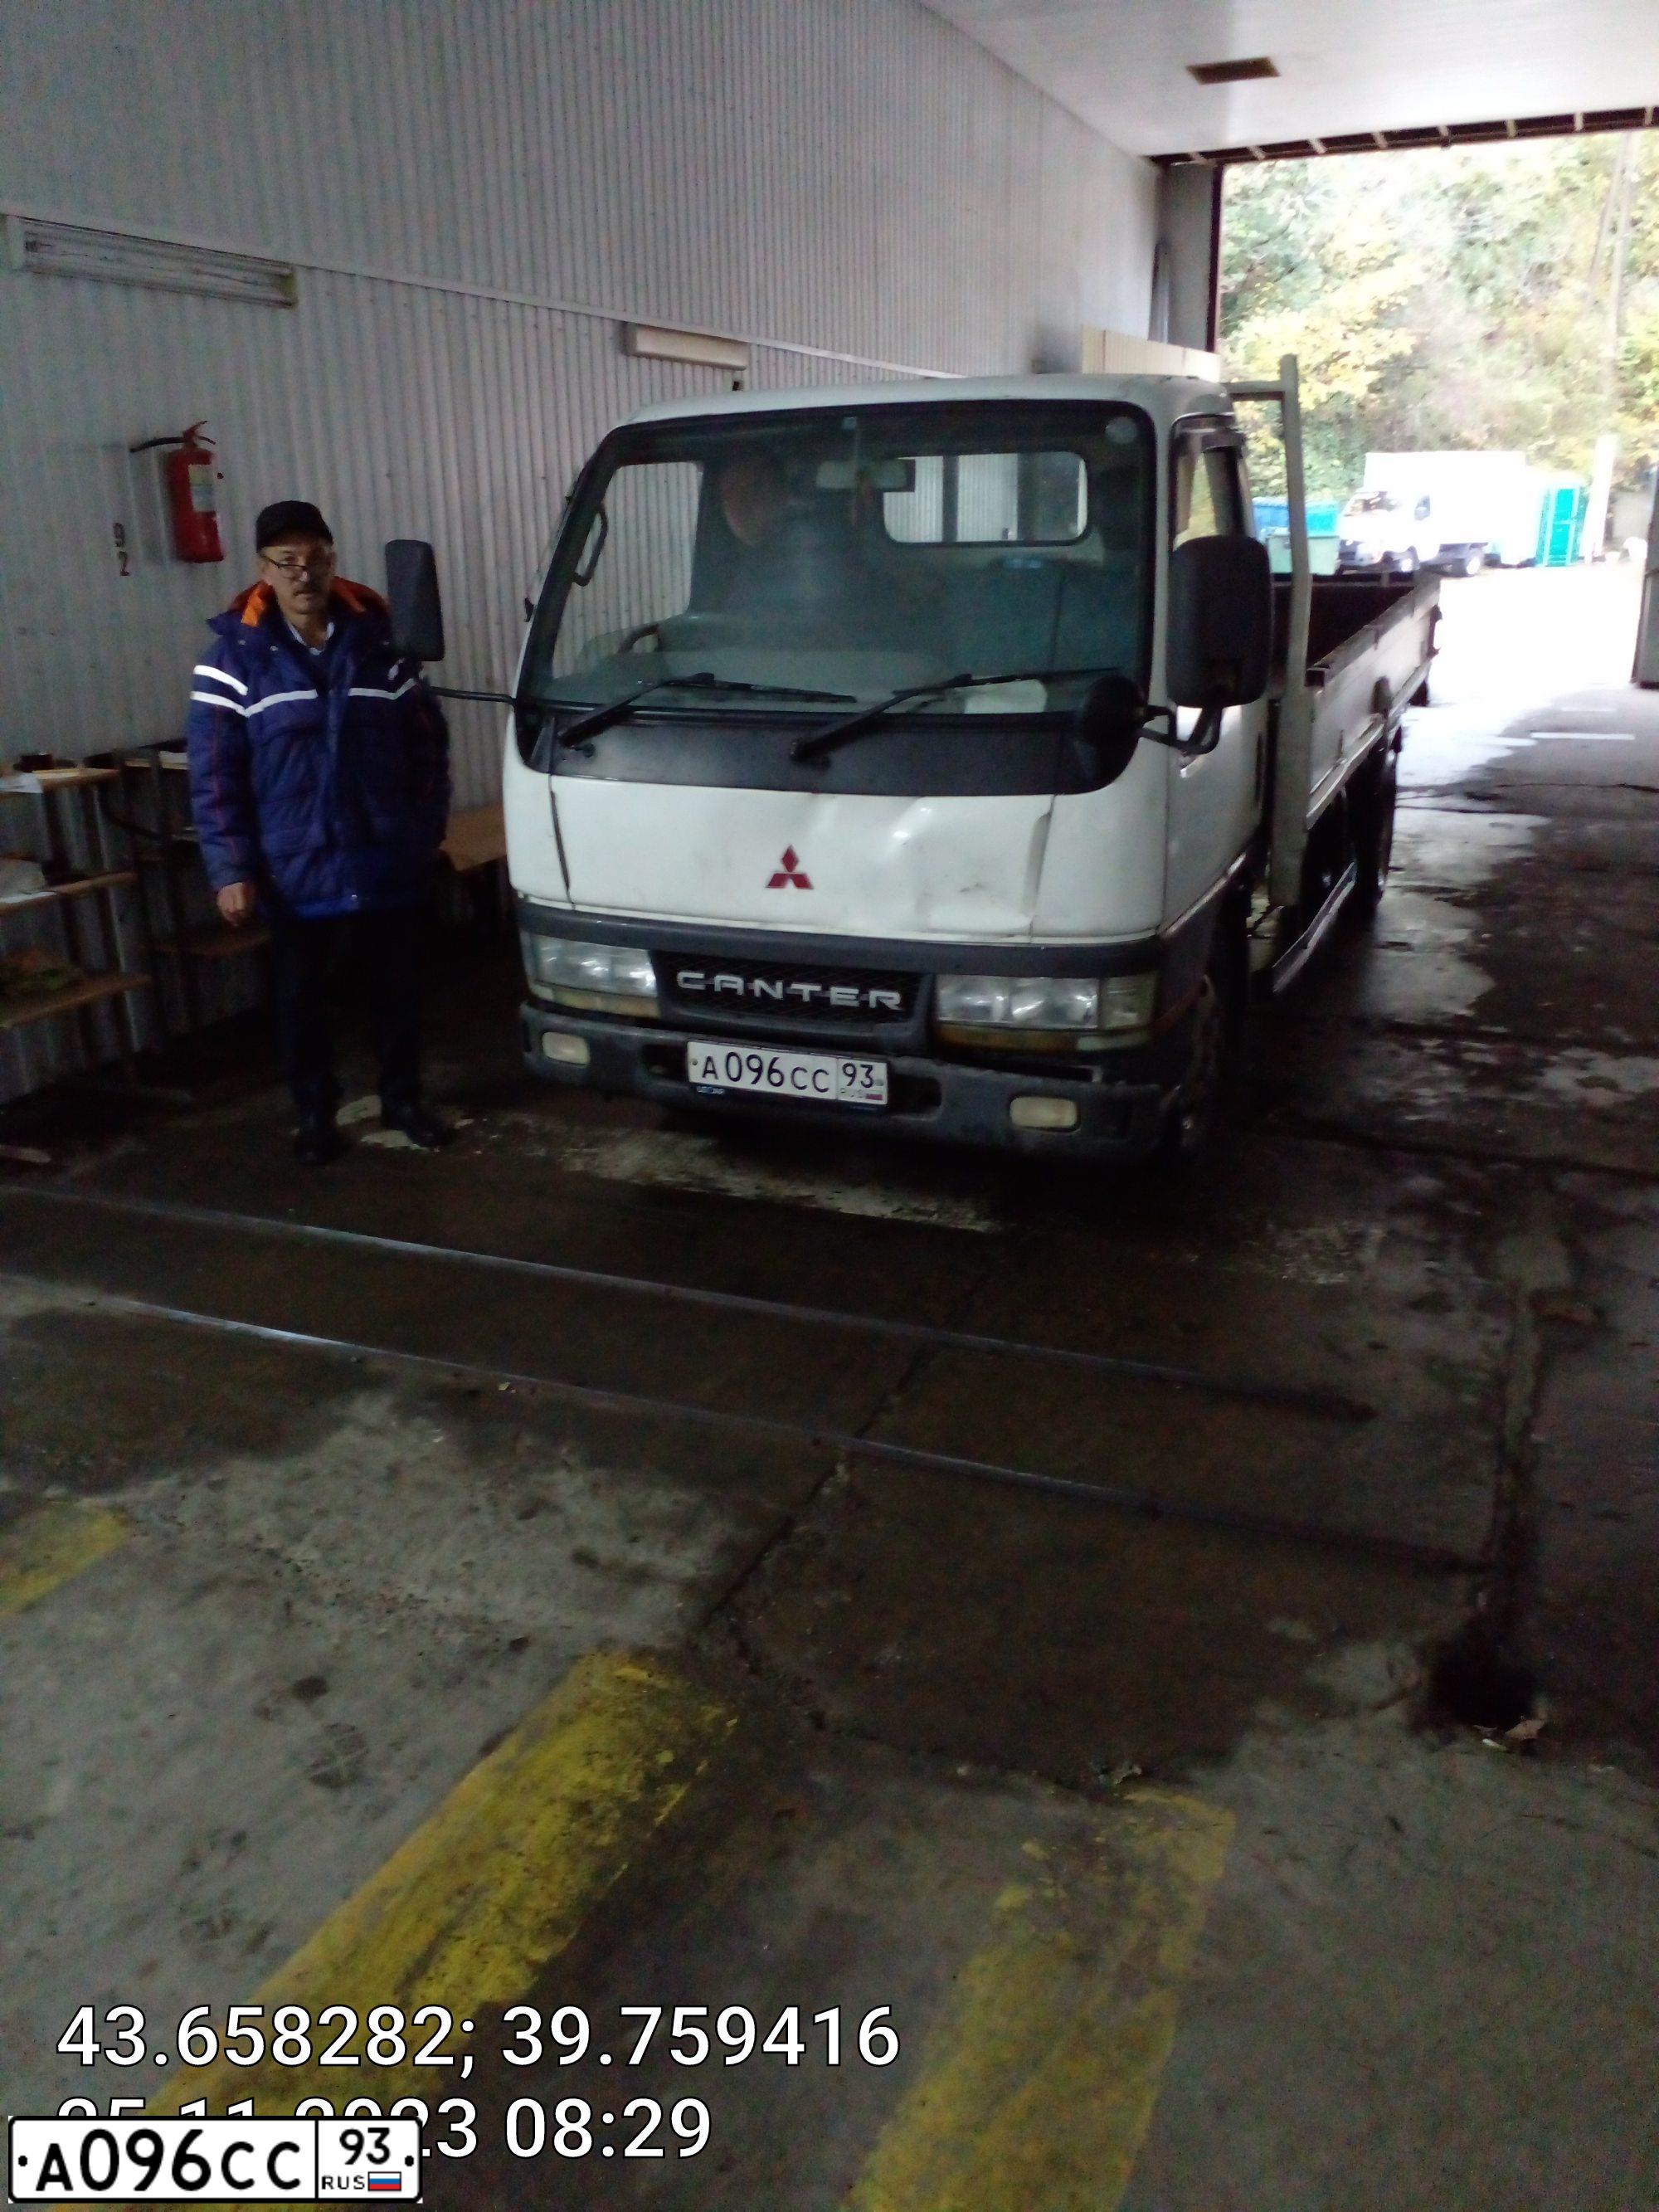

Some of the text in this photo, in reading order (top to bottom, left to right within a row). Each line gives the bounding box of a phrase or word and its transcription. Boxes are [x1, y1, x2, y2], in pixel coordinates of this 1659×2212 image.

[677, 970, 903, 1011] CANTER
[702, 1050, 874, 1093] A096CC 93
